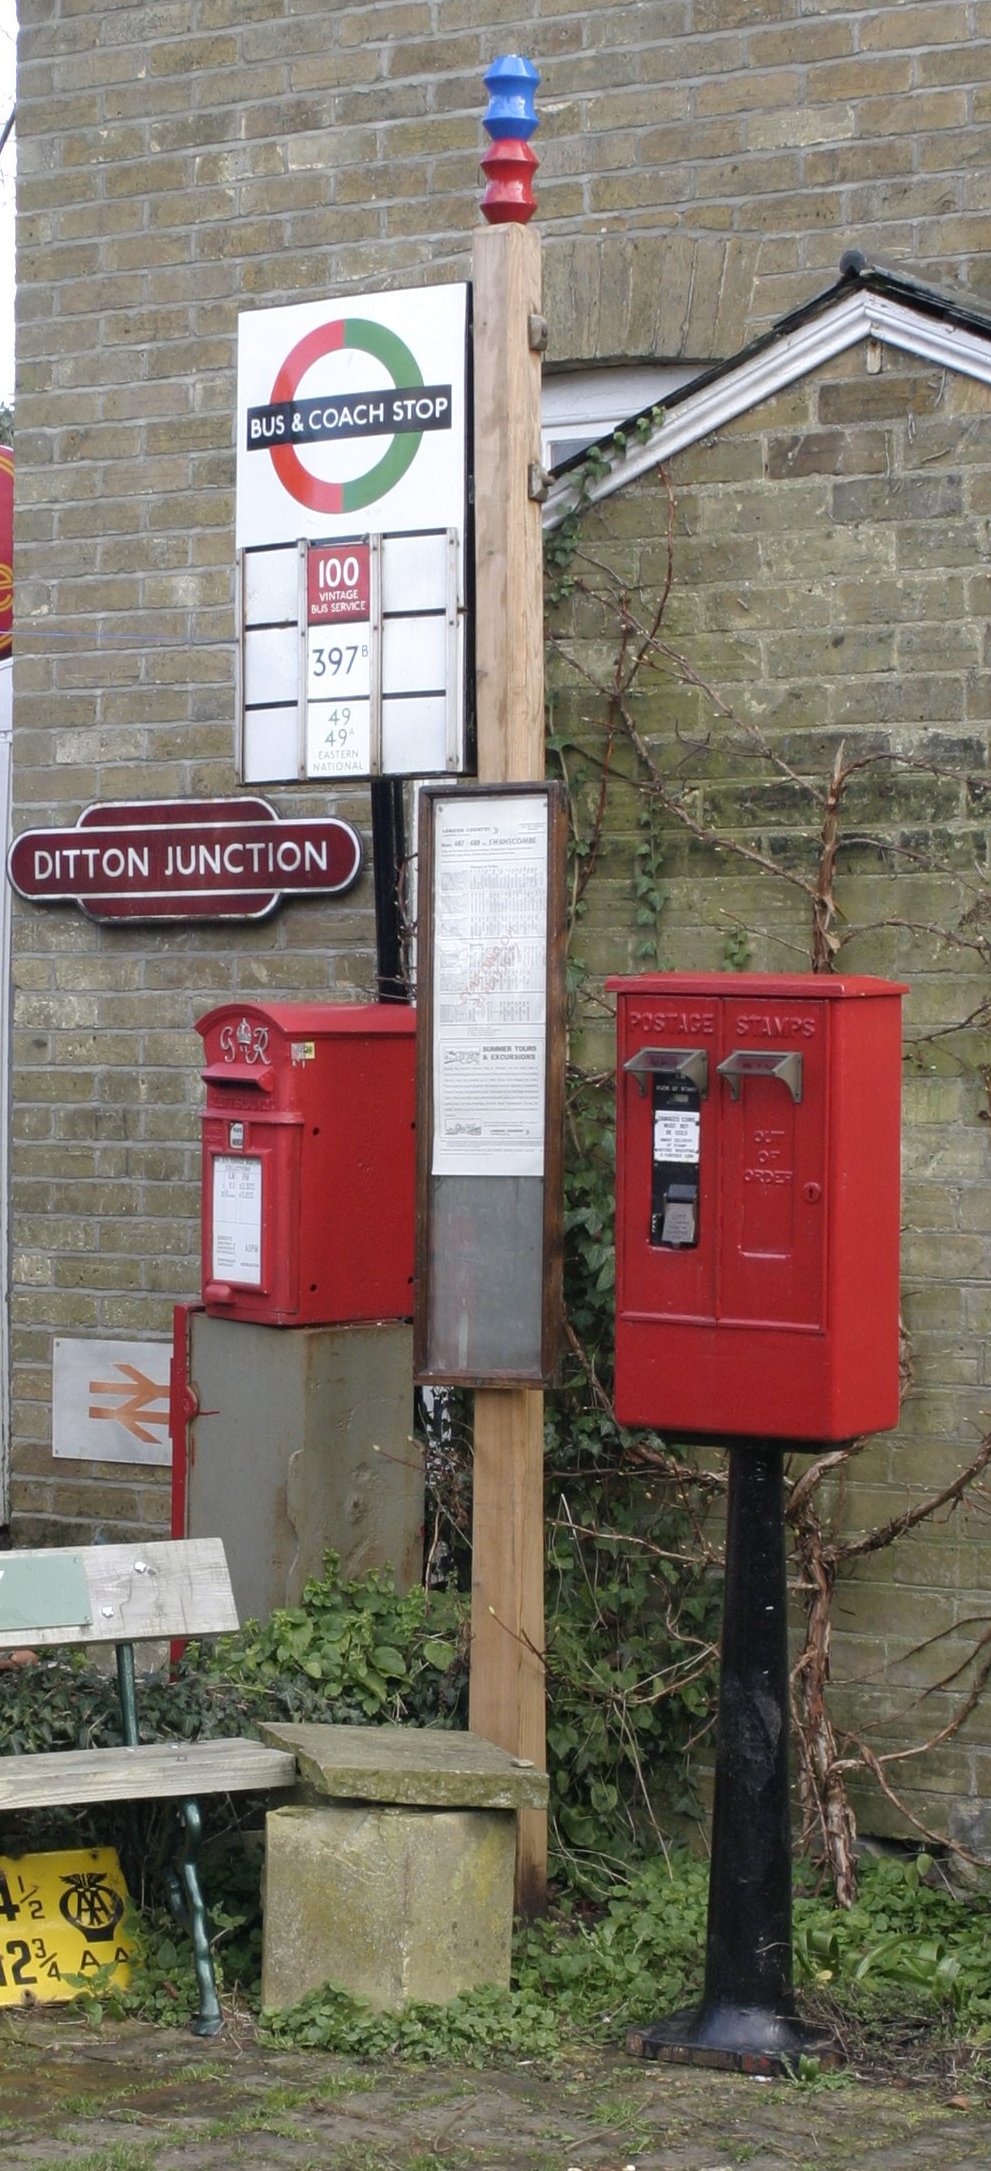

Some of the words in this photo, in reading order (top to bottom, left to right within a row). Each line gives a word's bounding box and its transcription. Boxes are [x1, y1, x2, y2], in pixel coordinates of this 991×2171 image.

[250, 412, 285, 439] BUS
[291, 412, 304, 432] &
[309, 403, 384, 430] COACH
[393, 397, 448, 422] STOP
[319, 556, 359, 588] 100
[319, 589, 359, 601] VINTAGE
[311, 603, 328, 614] BUS
[331, 601, 366, 612] SERVICE
[328, 707, 351, 726] 49
[318, 749, 360, 760] EASTERN
[312, 761, 364, 772] NATIONAL
[34, 847, 149, 880] DITTON
[165, 841, 327, 876] JUNCTION
[629, 1011, 714, 1034] POSTAGE
[736, 1014, 816, 1038] STAMPS
[753, 1130, 785, 1143] OUT
[758, 1150, 780, 1163] OF
[744, 1169, 793, 1184] ORDER
